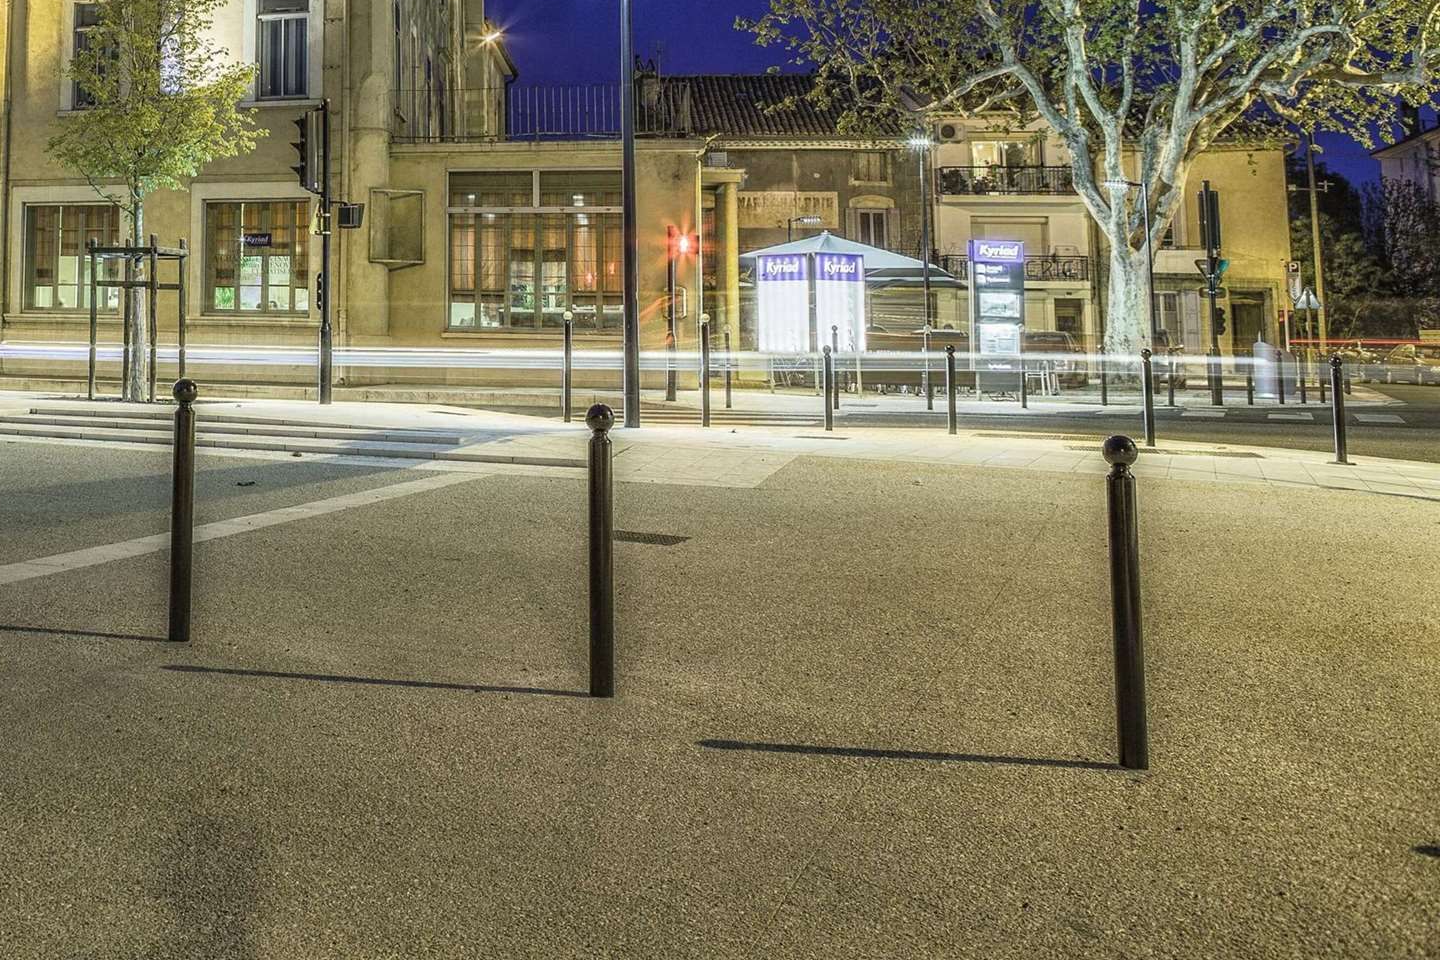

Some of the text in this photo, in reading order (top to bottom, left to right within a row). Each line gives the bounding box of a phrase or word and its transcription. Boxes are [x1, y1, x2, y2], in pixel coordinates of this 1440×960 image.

[979, 244, 1019, 258] Kyriad
[766, 260, 800, 276] Kyriad
[824, 260, 855, 275] Kyriad
[1289, 262, 1298, 272] P
